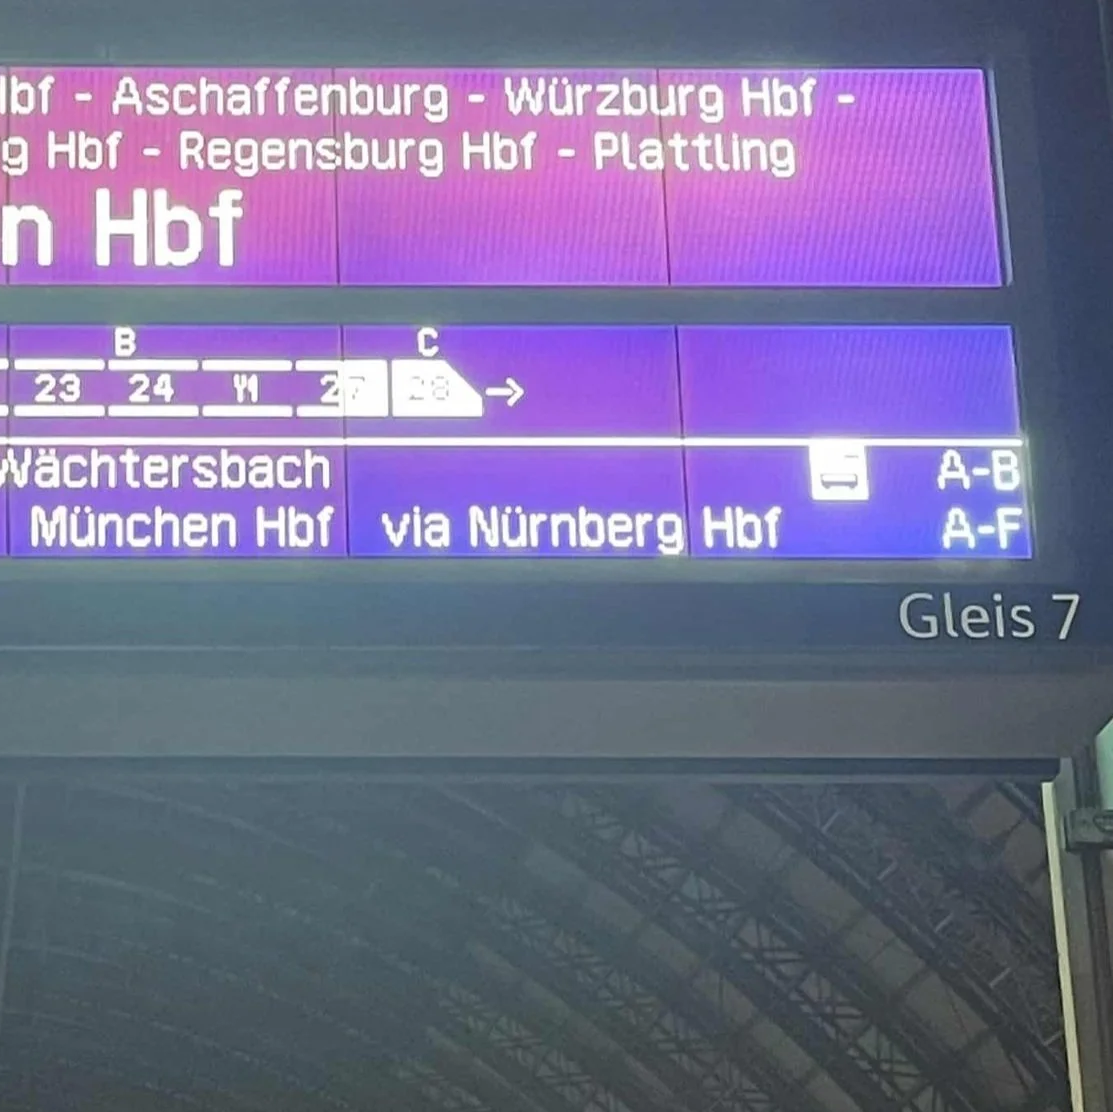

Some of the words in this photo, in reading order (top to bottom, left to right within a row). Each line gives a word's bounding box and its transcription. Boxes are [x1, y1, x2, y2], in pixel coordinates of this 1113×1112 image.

[112, 77, 449, 122] Aschaffenburg
[504, 77, 724, 123] Würzburg
[742, 78, 816, 117] Hbf
[48, 131, 122, 170] Hbf
[179, 131, 444, 177] Regensburg
[463, 132, 537, 171] Hbf
[594, 132, 795, 178] Plattling
[95, 188, 244, 267] Hbf
[114, 327, 136, 357] B
[417, 327, 439, 357] C
[35, 374, 82, 403] 23
[128, 374, 175, 403] 24
[937, 448, 1022, 491] A-B
[30, 505, 237, 548] München
[256, 506, 334, 548] Hbf
[381, 507, 450, 548] via
[469, 506, 684, 556] Nürnberg
[703, 506, 782, 549] Hbf
[942, 506, 1024, 550] A-F
[898, 591, 1036, 639] Gleis
[1050, 593, 1082, 640] 7
